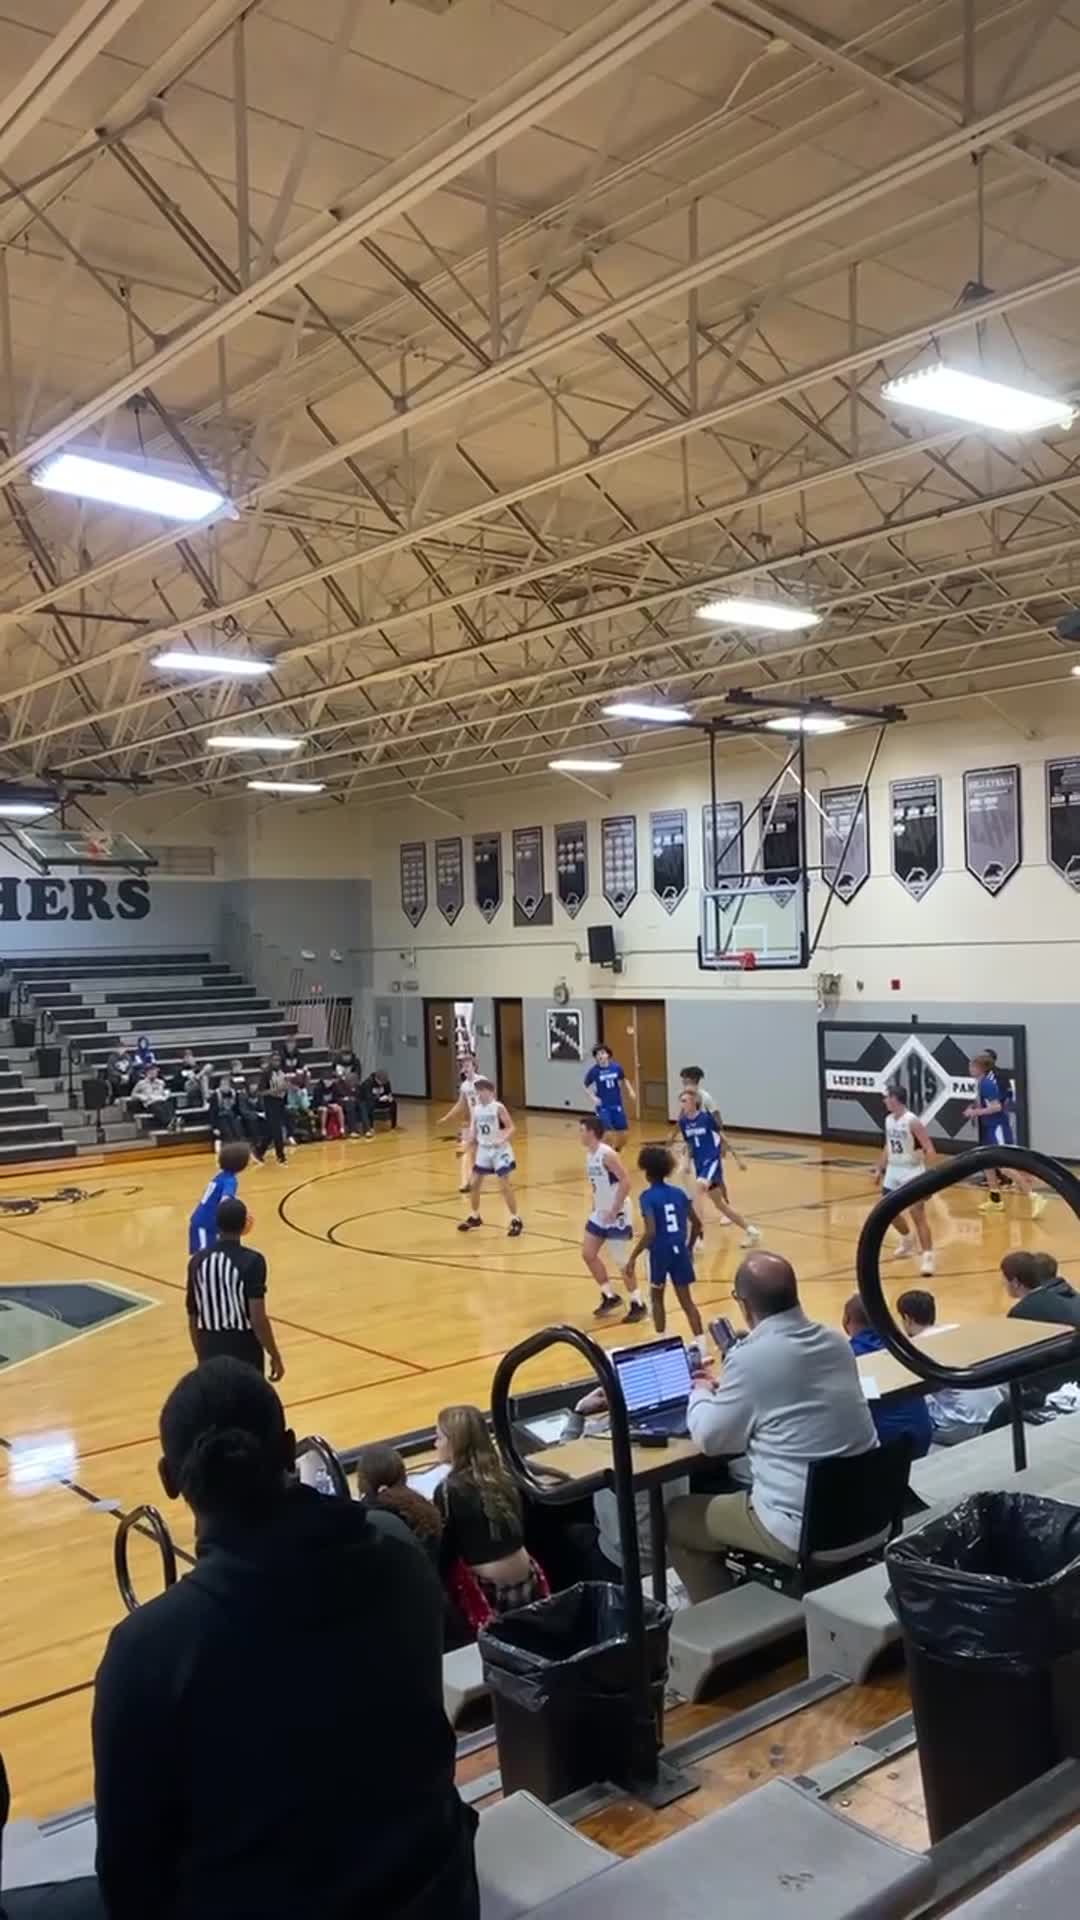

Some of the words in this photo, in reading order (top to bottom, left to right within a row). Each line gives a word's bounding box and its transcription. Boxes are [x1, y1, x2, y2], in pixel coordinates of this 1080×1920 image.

[832, 1075, 875, 1087] LEDFORD
[890, 1139, 904, 1154] 13
[664, 1203, 679, 1233] 5
